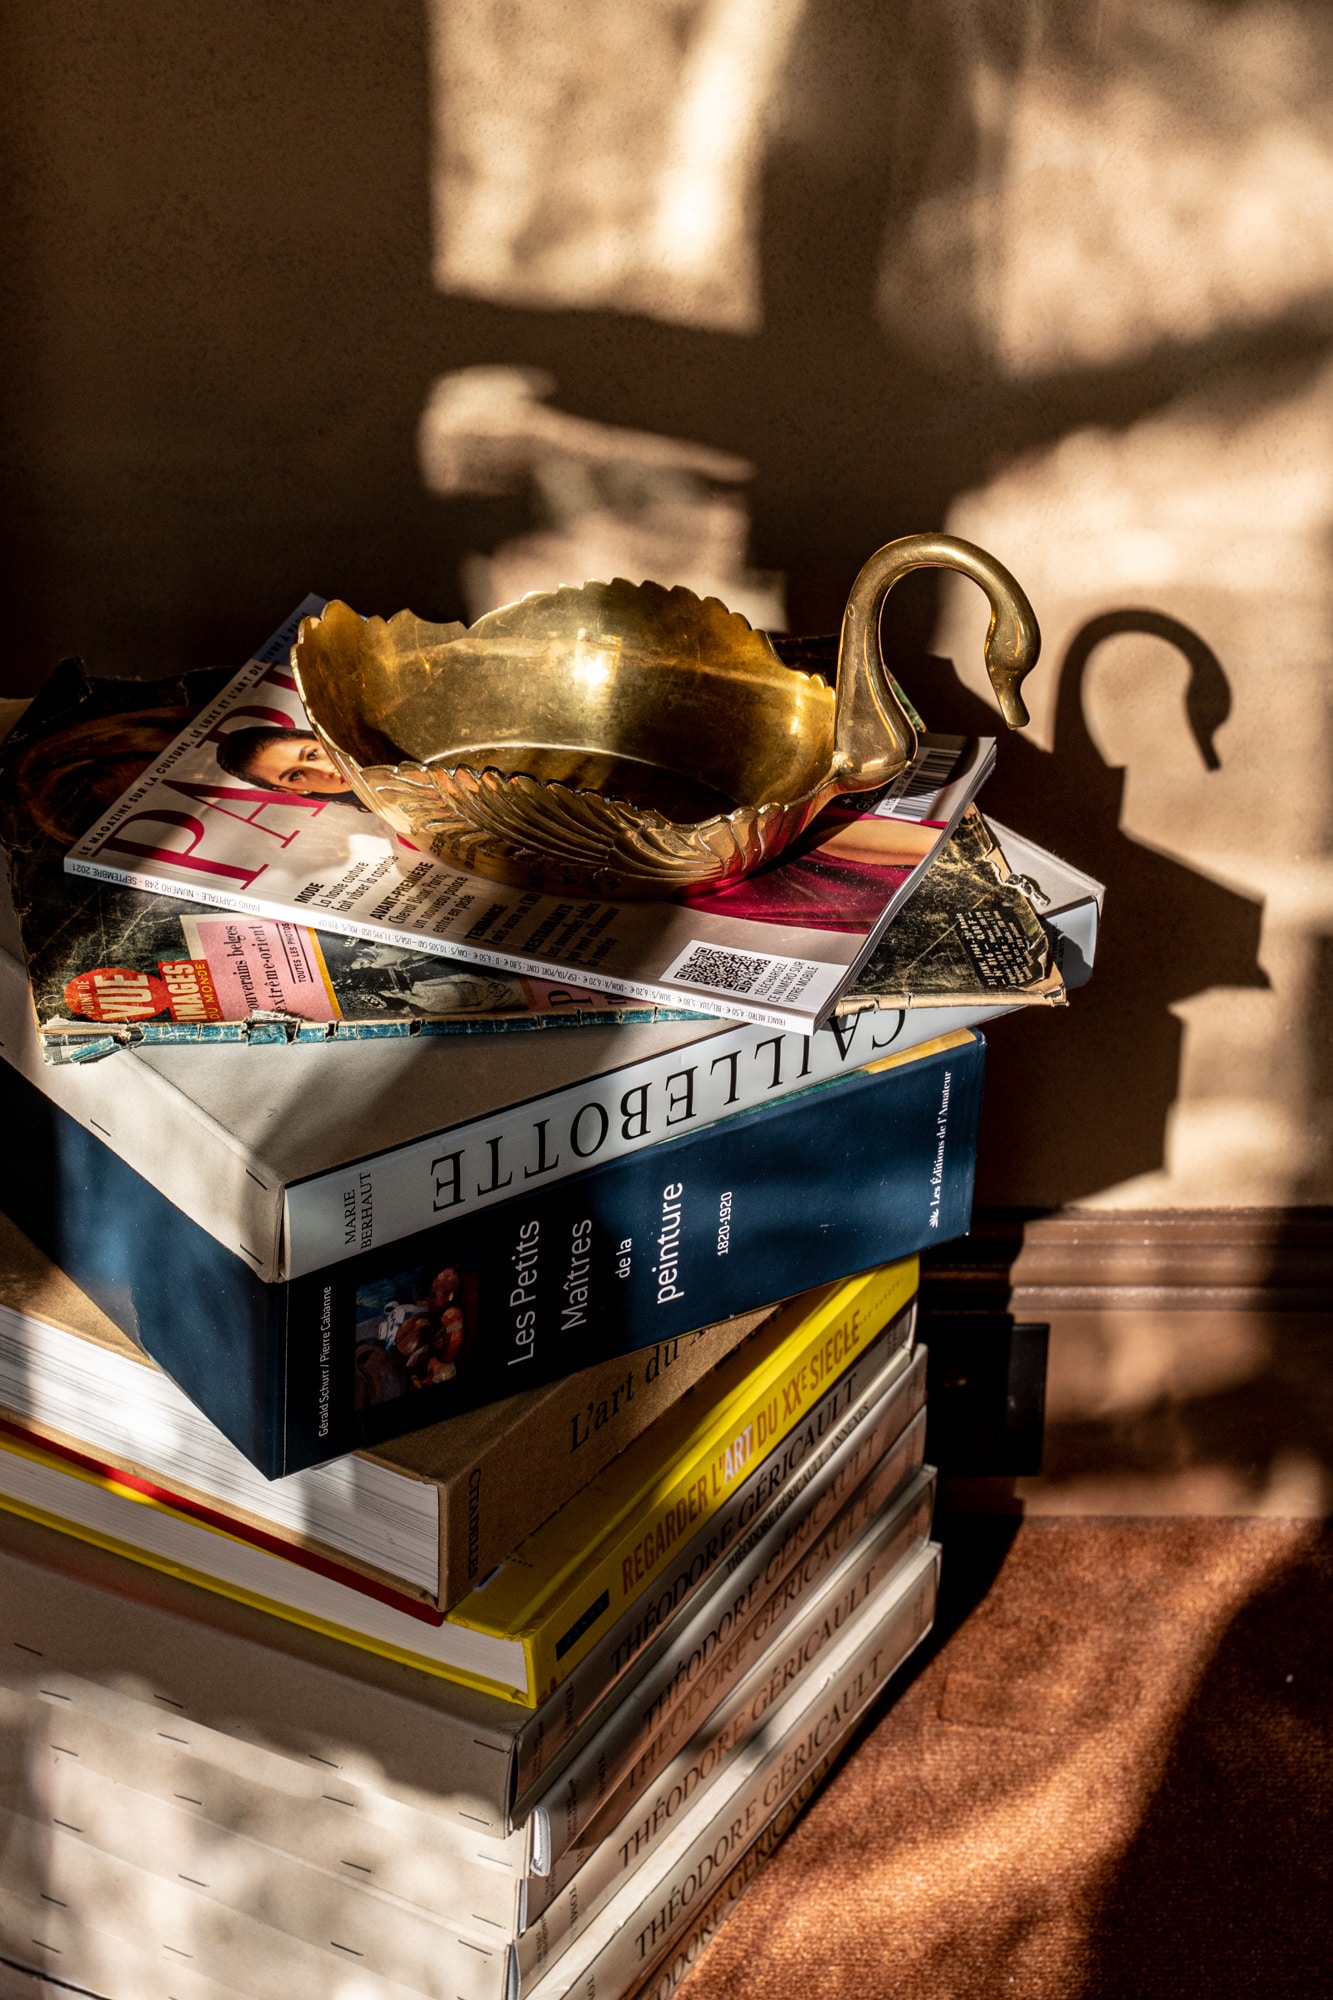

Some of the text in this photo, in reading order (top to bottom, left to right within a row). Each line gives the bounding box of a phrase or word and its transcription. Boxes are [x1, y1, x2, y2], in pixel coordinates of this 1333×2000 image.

[78, 845, 91, 856] LE
[89, 803, 132, 846] MAGAZINE
[129, 787, 150, 804] SUR
[145, 775, 158, 790] LA
[190, 730, 204, 742] LE
[200, 708, 222, 734] LUXE
[218, 698, 230, 710] ET
[250, 664, 262, 677] DE
[72, 863, 261, 913] PARIS CAPITALE NUMÉRO 248 SEPTEMBRE 2021
[294, 882, 325, 904] MODE
[312, 861, 369, 908] La haute couture
[331, 855, 399, 913] fait vibrer la capitale
[369, 861, 434, 920] AVANT-PREMIÈRE
[388, 873, 452, 924] Cheval Blanc Paris,
[412, 876, 469, 929] un nouveau palace
[432, 894, 476, 934] entre en piste
[464, 903, 510, 941] TENDANCE
[484, 924, 510, 946] Paris
[520, 903, 575, 954] RESTAURANTS
[224, 925, 260, 1012] ouverains belges
[282, 922, 307, 983] TOUTES LES PHOTOS
[754, 962, 788, 996] TÉLÉCHARGEZ
[970, 944, 984, 958] 1964
[984, 952, 998, 966] 816
[76, 980, 95, 1014] POINT DE
[94, 974, 156, 1020] VUE
[162, 963, 208, 1020] IMAGES
[195, 963, 220, 1020] DU MONDE
[768, 961, 806, 1002] CE NUMÉRO SUR
[784, 966, 818, 1002] VOTRE MOBILE
[986, 978, 998, 986] 31
[767, 1014, 786, 1026] FRANCE
[430, 1008, 908, 1213] CAILLEBOTTE
[930, 1071, 952, 1206] Les Éditions de l'Amateur
[344, 1189, 357, 1246] MARIE
[360, 1172, 373, 1250] BERHAUT
[716, 1191, 733, 1257] 1820-1920
[615, 1238, 632, 1280] de la
[651, 1182, 685, 1306] peinture
[507, 1219, 541, 1366] Les Petits
[560, 1218, 594, 1332] Maîtres
[318, 1286, 332, 1438] Gérald Schurr Pierre Cabanne
[570, 1339, 682, 1454] L'art du
[467, 1468, 484, 1582] CITADELLES
[610, 1371, 858, 1674] THÉODORE GÉRICAULT
[622, 1476, 709, 1596] REGARDER
[712, 1423, 756, 1496] L'ART
[756, 1397, 779, 1449] DU
[725, 1508, 776, 1576] THÉODORE
[774, 1456, 828, 1516] GÉRICAULT
[642, 1428, 880, 1737] THÉODORE GÉRICAULT
[628, 1484, 875, 1791] THÉODORE GÉRICAULT
[618, 1565, 876, 1869] THÉODORE GÉRICAULT
[634, 1650, 885, 1962] THÉODORE GÉRICAULT
